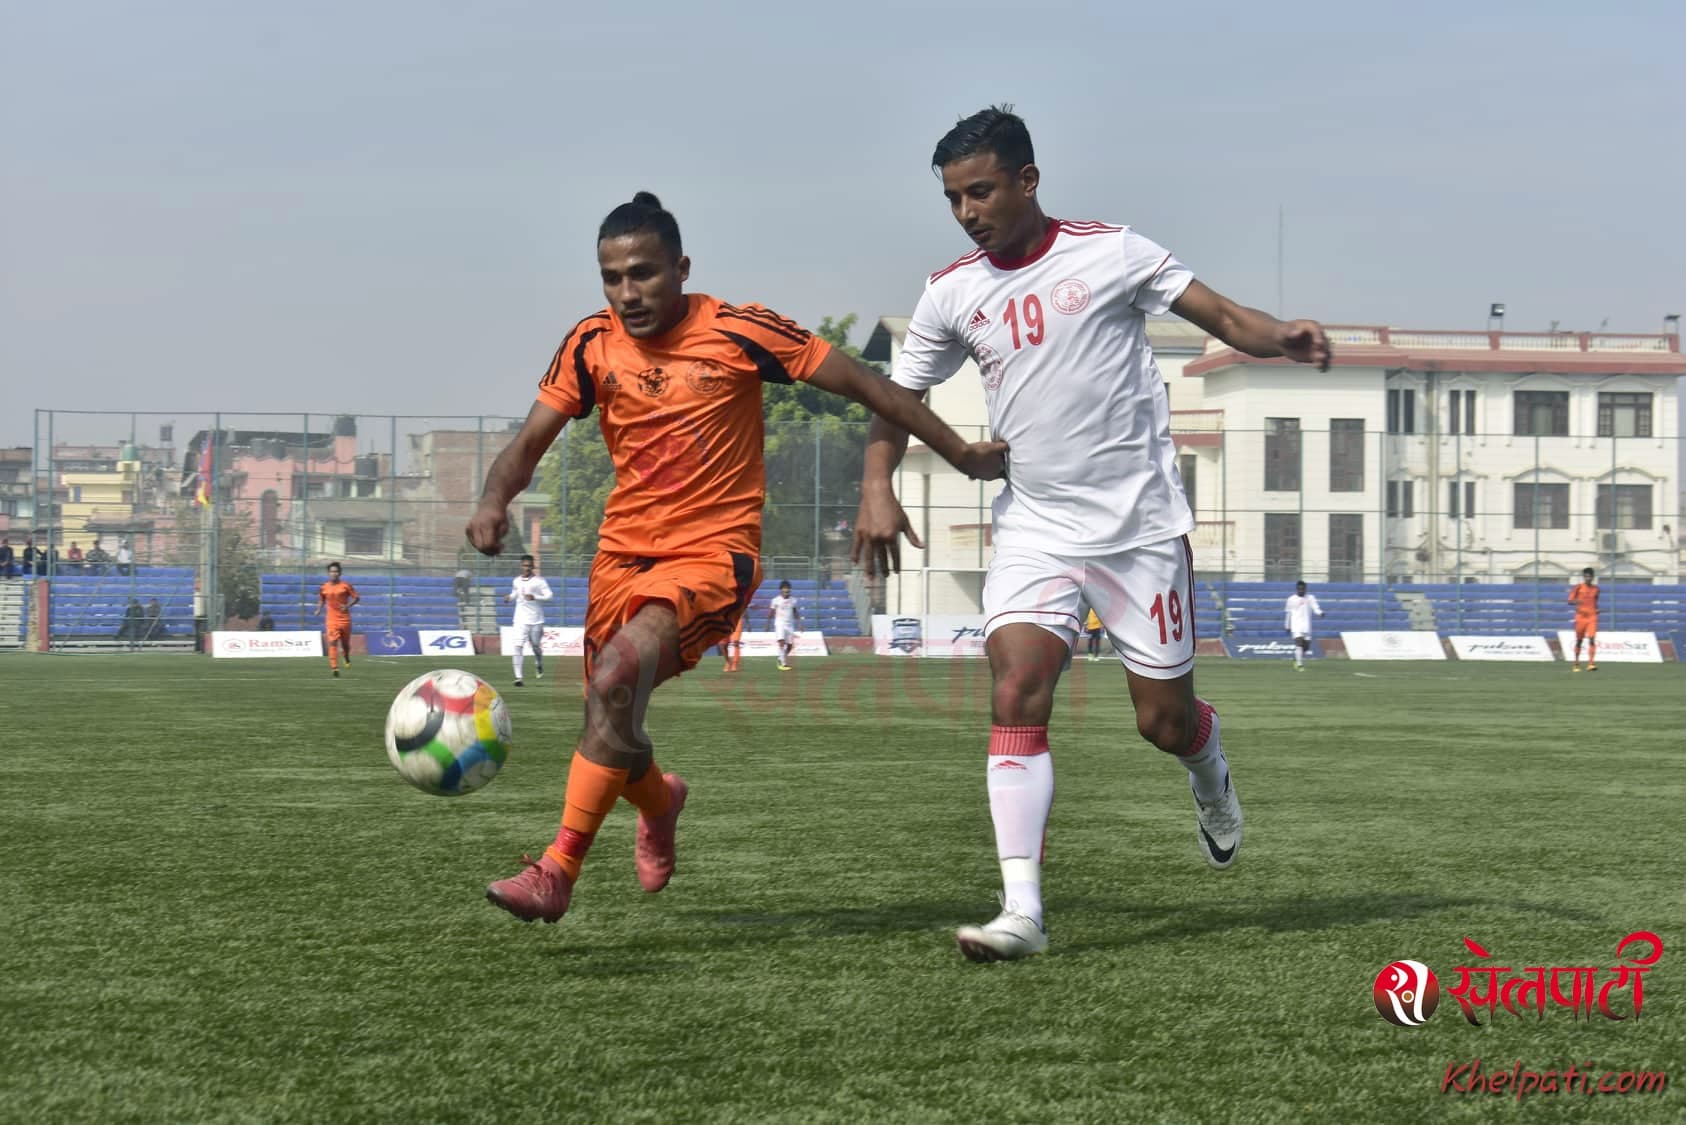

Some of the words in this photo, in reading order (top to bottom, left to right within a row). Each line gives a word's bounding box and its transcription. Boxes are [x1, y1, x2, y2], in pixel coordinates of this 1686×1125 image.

[1003, 293, 1045, 350] 19
[429, 635, 468, 650] 4G
[1150, 589, 1185, 645] 19
